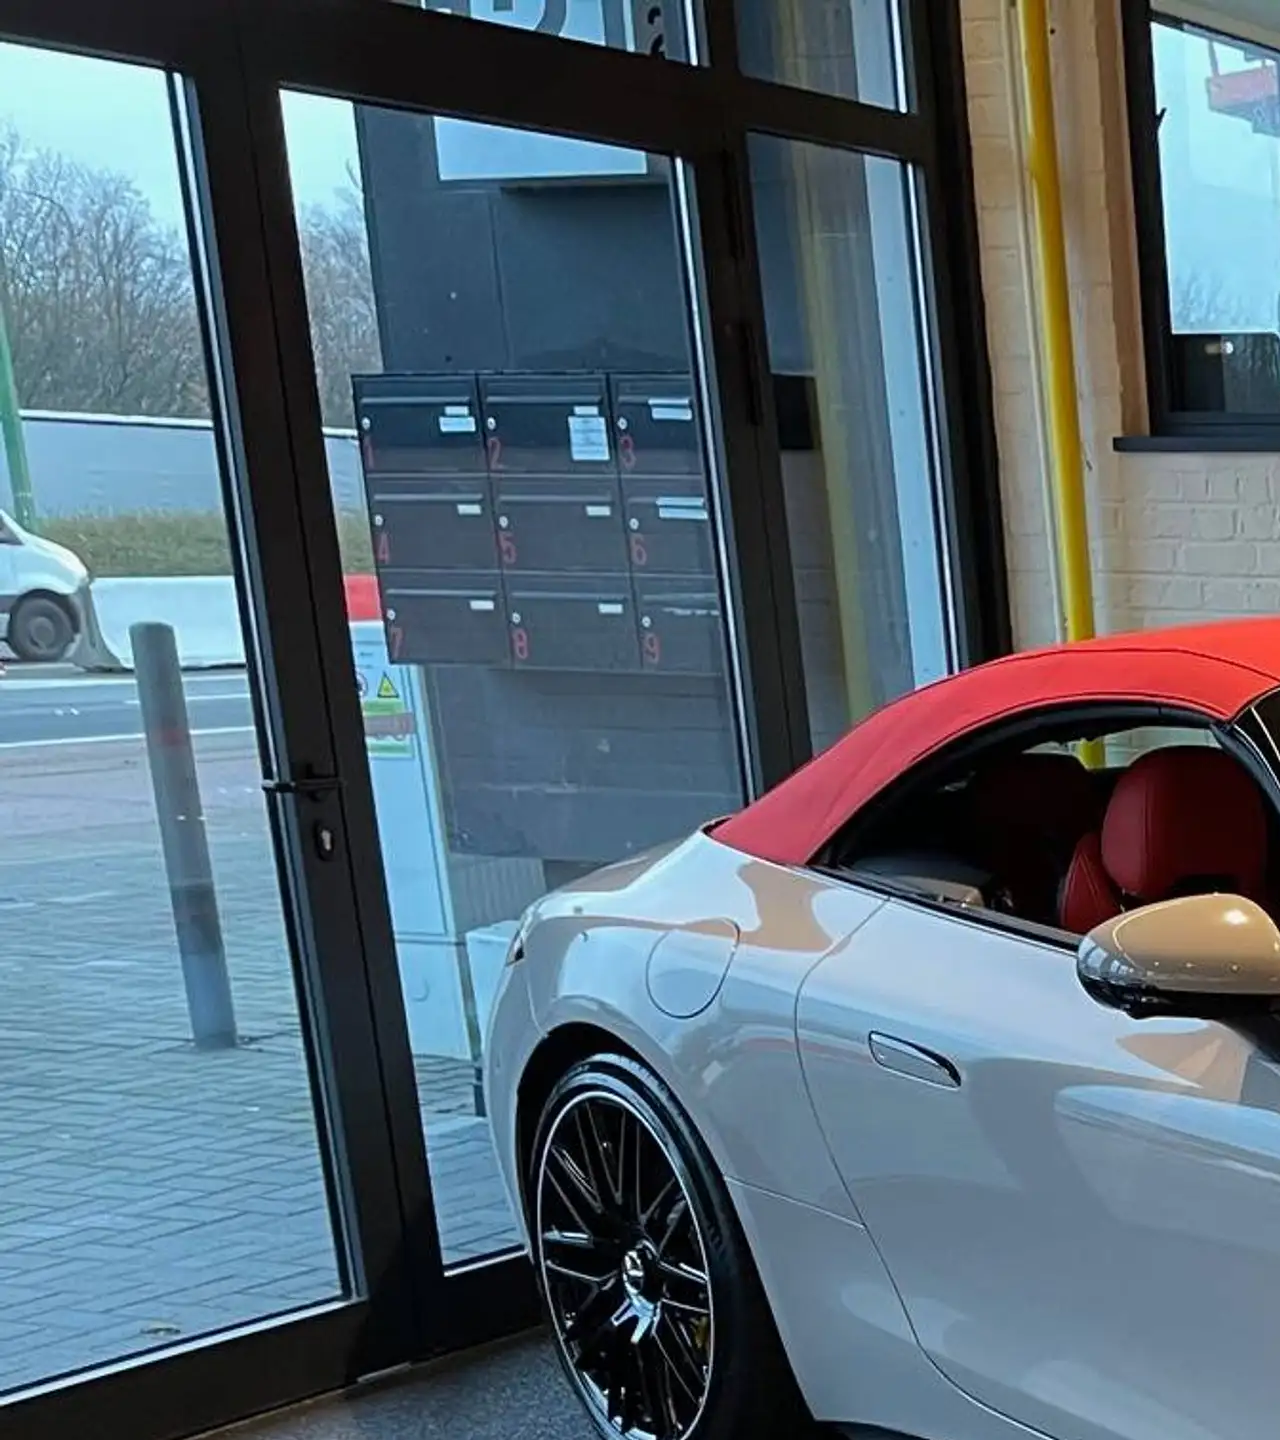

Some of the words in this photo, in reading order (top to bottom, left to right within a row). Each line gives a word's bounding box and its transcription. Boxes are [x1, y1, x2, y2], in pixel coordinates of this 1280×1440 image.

[363, 443, 375, 469] 1
[487, 437, 505, 469] 2
[619, 436, 637, 468] 3
[376, 532, 391, 563] 4
[498, 532, 516, 564] 5
[630, 533, 647, 565] 6
[390, 627, 403, 659] 7
[511, 627, 529, 659] 8
[643, 633, 660, 663] 9
